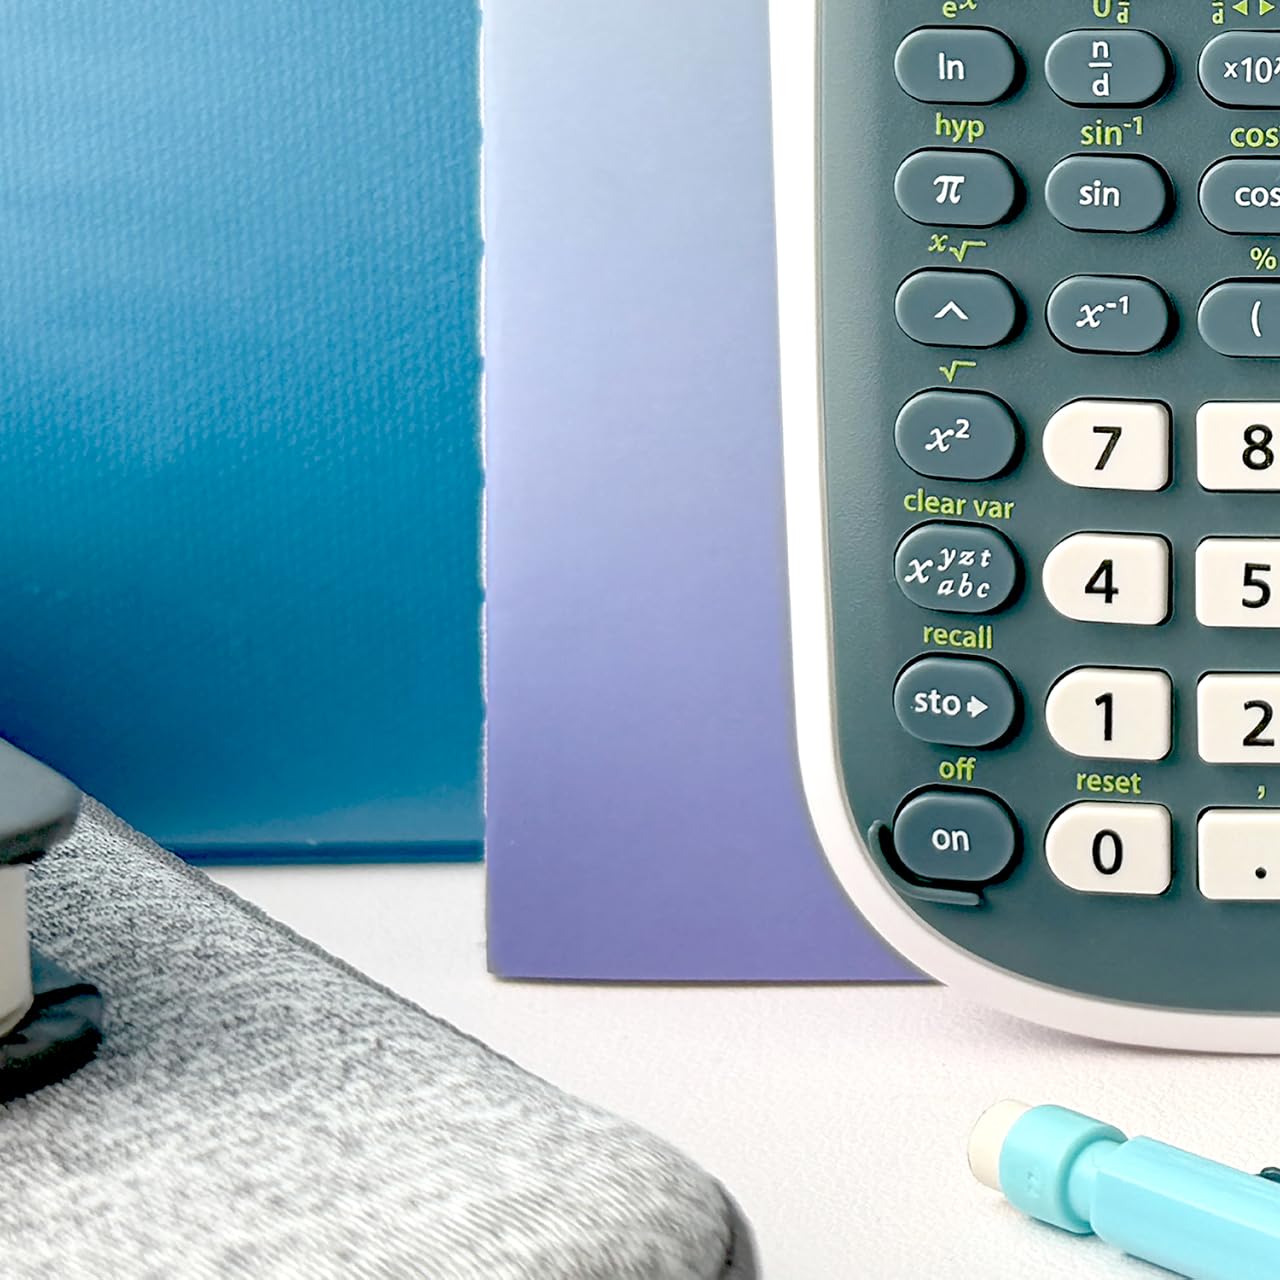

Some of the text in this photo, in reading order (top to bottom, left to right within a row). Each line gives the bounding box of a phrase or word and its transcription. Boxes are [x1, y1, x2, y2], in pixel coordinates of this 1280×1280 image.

[938, 52, 964, 80] ln
[935, 111, 985, 144] hyp
[1079, 179, 1120, 207] sin
[1250, 248, 1277, 270] %
[1092, 426, 1122, 471] 7
[1242, 424, 1275, 471] 8
[903, 488, 1014, 520] clear var
[1084, 559, 1119, 604] 4
[1241, 562, 1271, 609] 5
[923, 626, 992, 650] recall
[914, 689, 961, 716] sto
[1095, 692, 1113, 742] 1
[1242, 700, 1275, 747] 2
[938, 756, 977, 782] off
[1076, 773, 1142, 795] reset
[932, 829, 970, 851] on
[1091, 829, 1123, 876] 0
